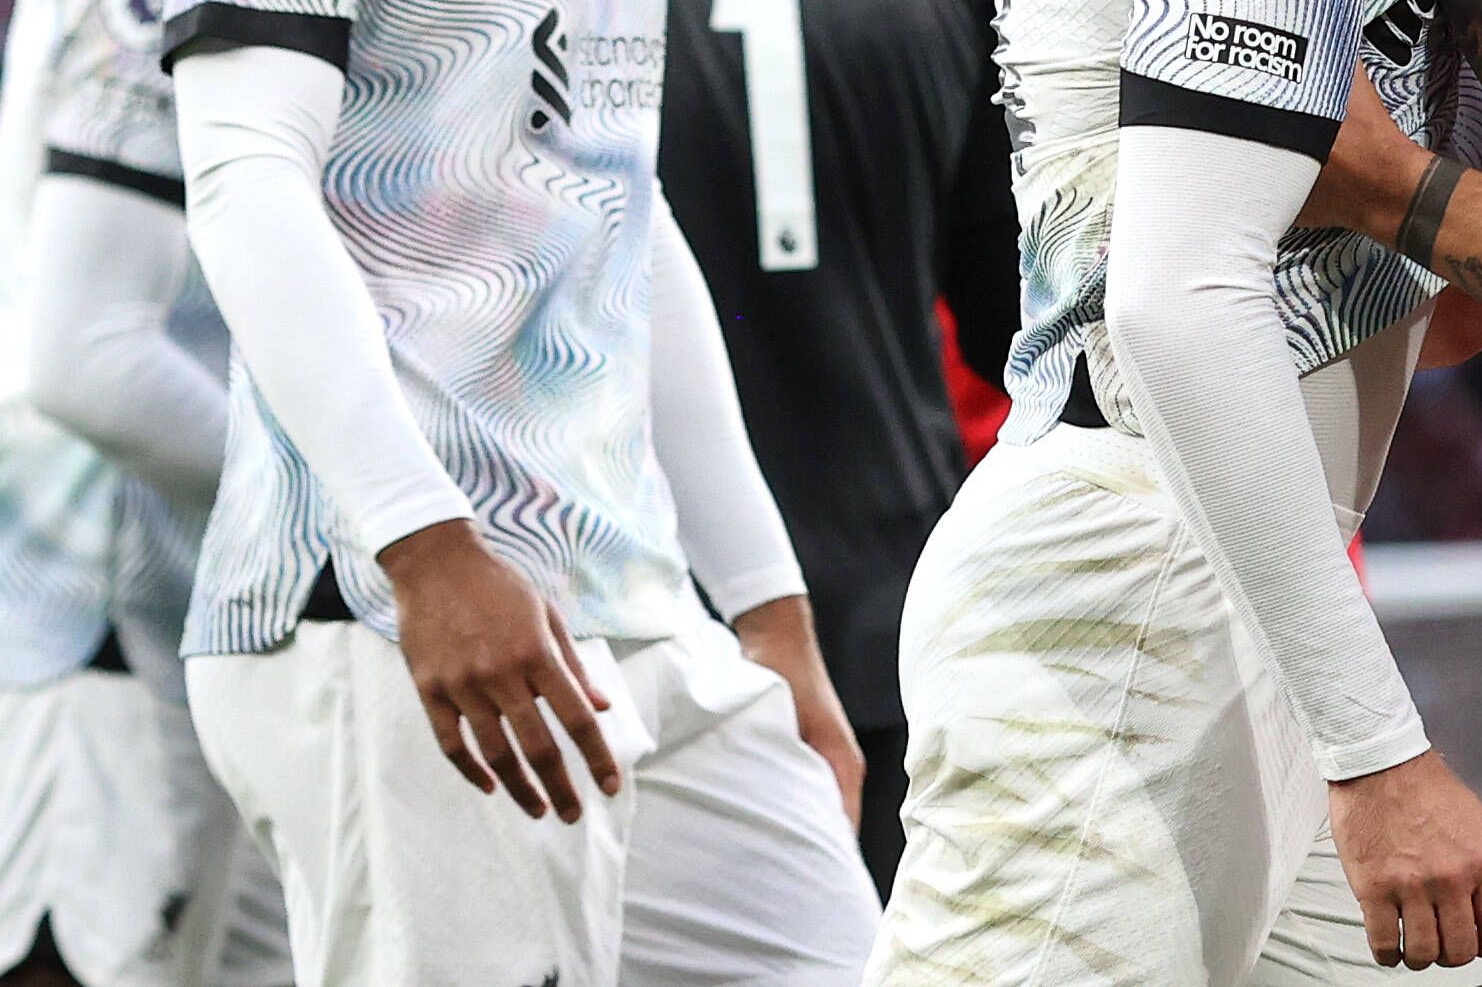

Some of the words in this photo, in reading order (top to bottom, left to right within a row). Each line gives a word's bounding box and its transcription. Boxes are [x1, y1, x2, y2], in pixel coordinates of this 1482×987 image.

[1185, 35, 1227, 63] for
[1228, 44, 1303, 84] racism
[1188, 13, 1229, 42] No
[1233, 24, 1297, 60] room
